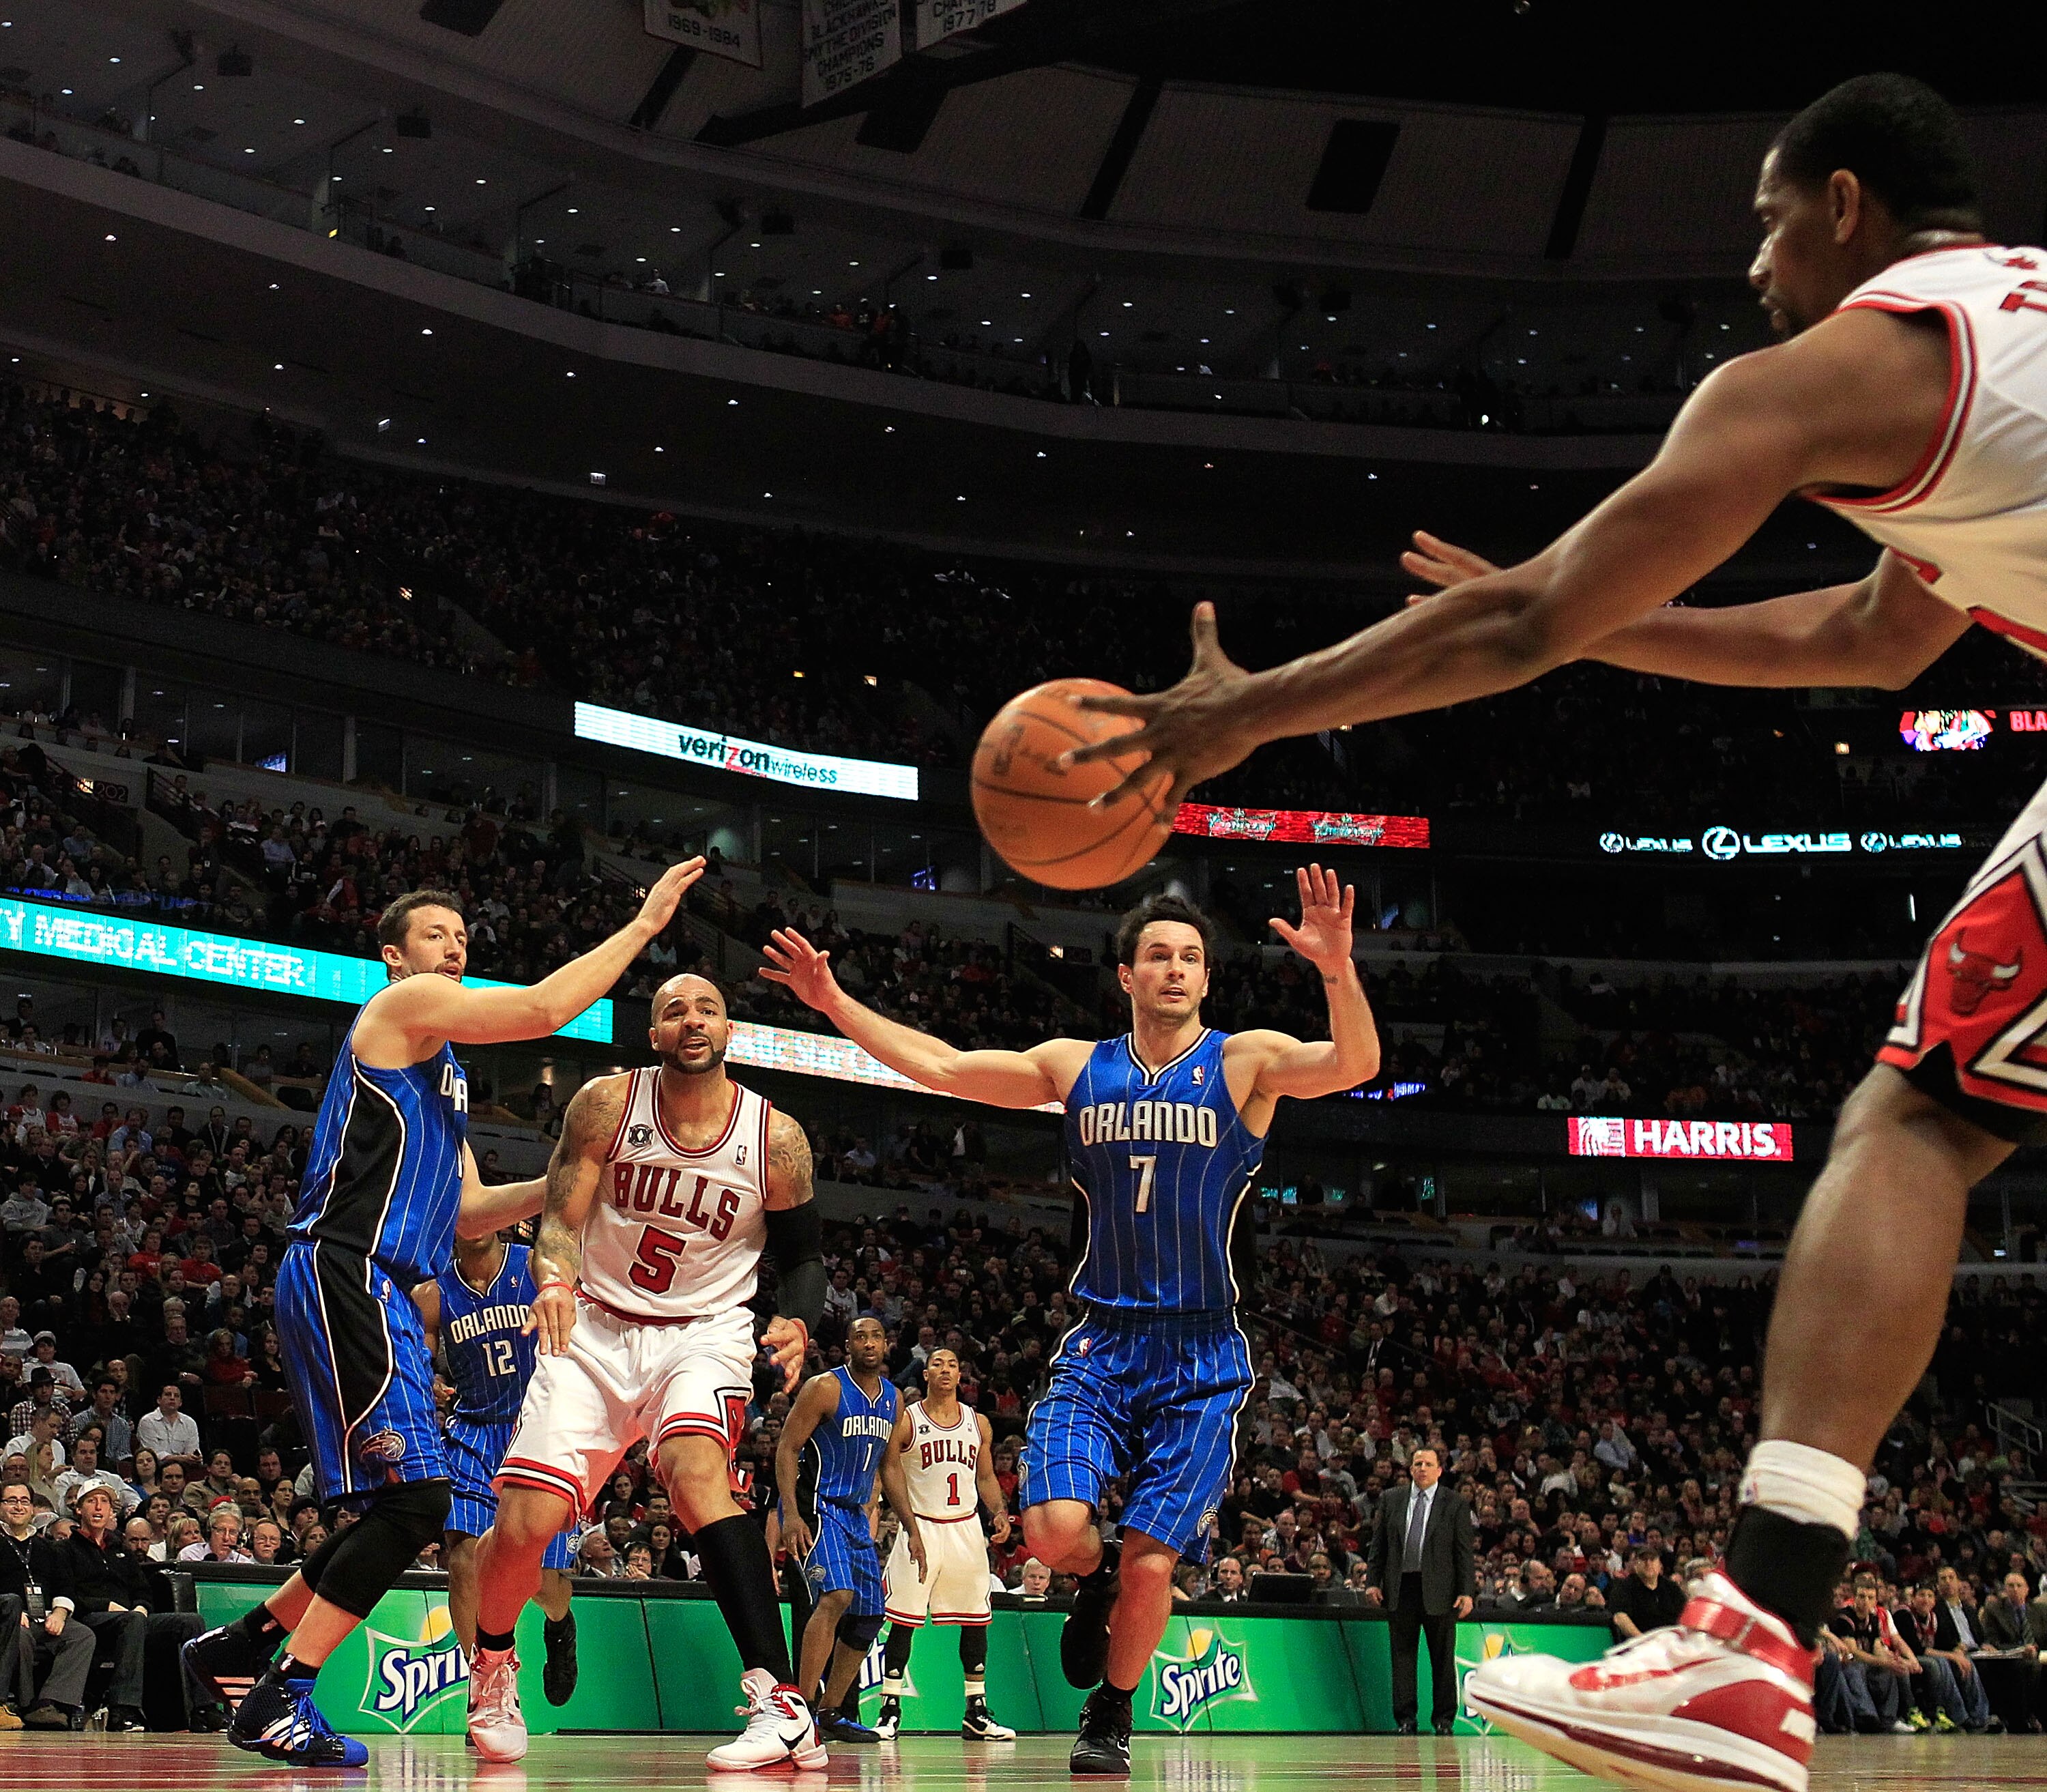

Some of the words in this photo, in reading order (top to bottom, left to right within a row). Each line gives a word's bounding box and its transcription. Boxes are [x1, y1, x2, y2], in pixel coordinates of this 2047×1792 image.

[668, 13, 740, 48] 1969-1984
[679, 735, 770, 774] verizon
[771, 760, 838, 784] wireless
[1743, 833, 1852, 853] LEXUS
[35, 914, 177, 966] MEDICAL
[186, 940, 305, 987] CENTER
[1079, 1100, 1217, 1147] ORLANDO
[614, 1161, 740, 1241] BULLS
[1129, 1155, 1157, 1213] 7
[627, 1224, 686, 1295] 5
[482, 1340, 517, 1377] 12
[863, 1443, 873, 1472] 1
[920, 1439, 977, 1471] BULLS
[946, 1472, 961, 1507] 1
[1161, 1640, 1242, 1724] Sprite
